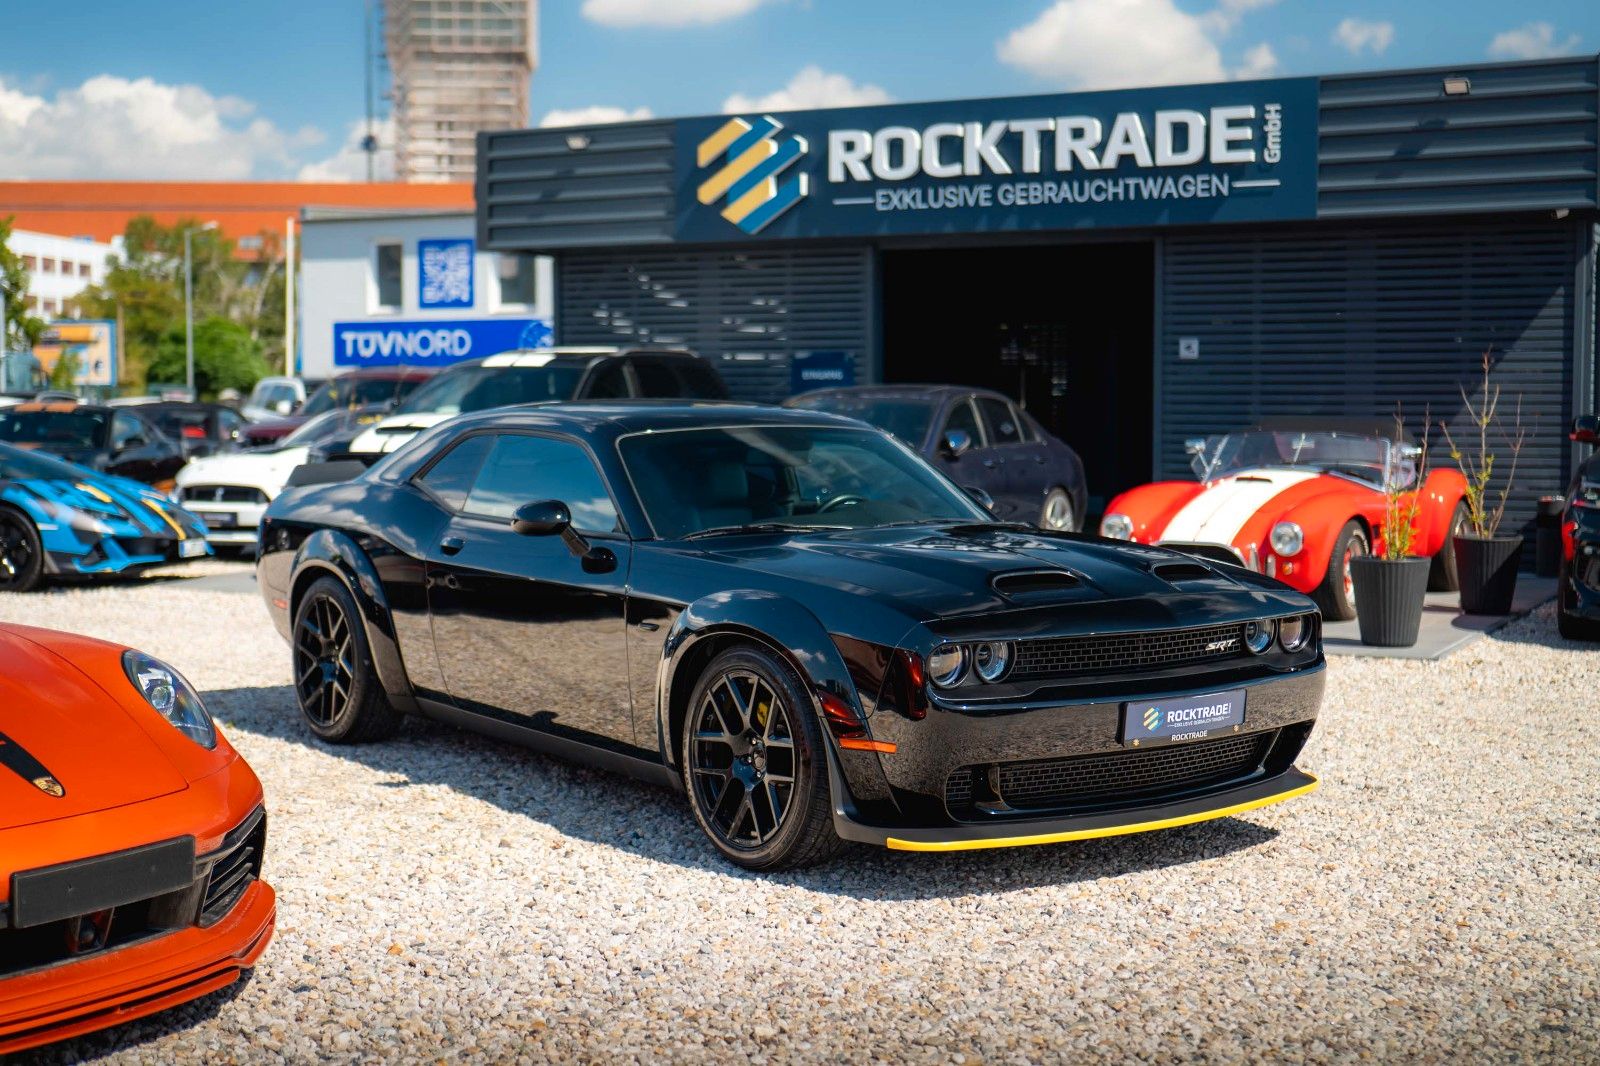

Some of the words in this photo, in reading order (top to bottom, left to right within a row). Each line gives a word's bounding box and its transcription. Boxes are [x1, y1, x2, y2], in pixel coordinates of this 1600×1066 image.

[828, 105, 1256, 183] ROCKTRADE
[1263, 103, 1282, 164] GmbH
[875, 184, 993, 211] EXKLUSIVE
[997, 173, 1230, 206] GEBRAUCHTWAGEN
[1205, 640, 1236, 651] SRT
[1167, 703, 1229, 723] ROCKTRADE
[1171, 729, 1208, 742] ROCKTRADE
